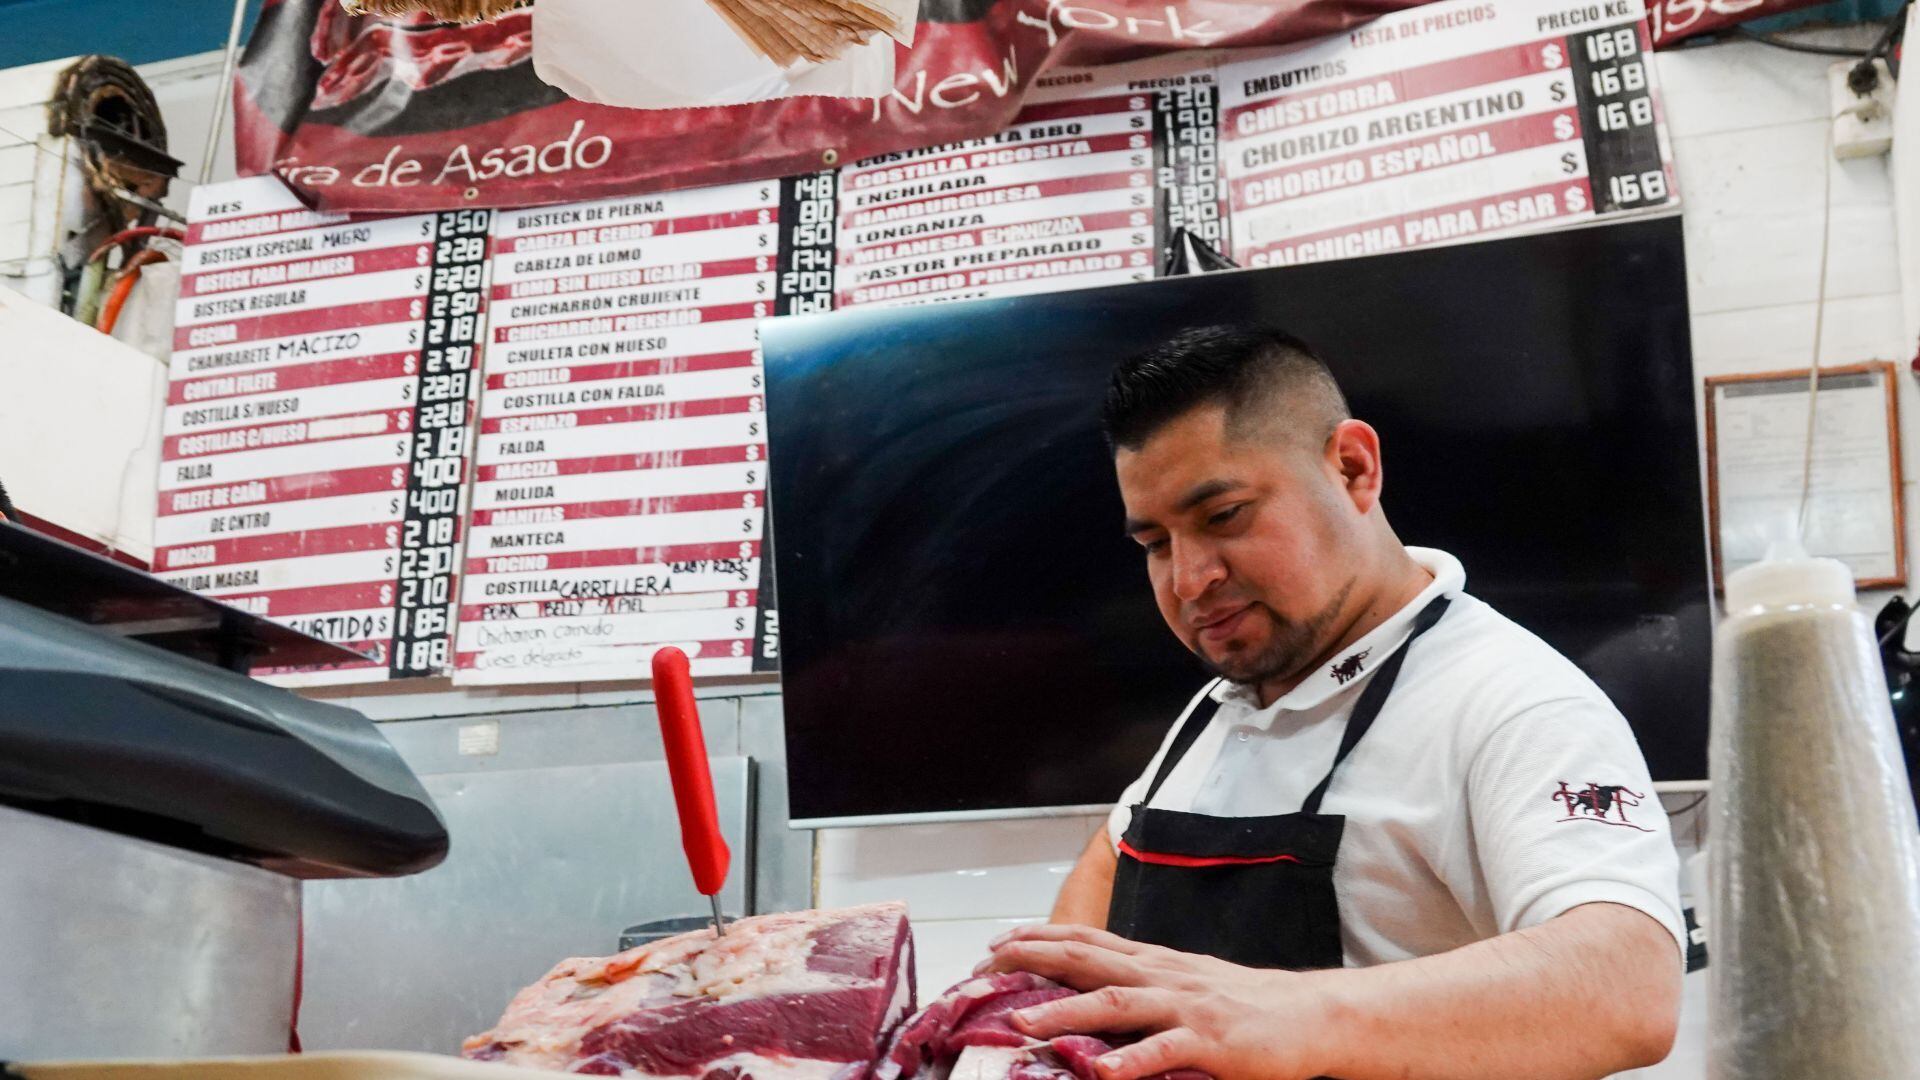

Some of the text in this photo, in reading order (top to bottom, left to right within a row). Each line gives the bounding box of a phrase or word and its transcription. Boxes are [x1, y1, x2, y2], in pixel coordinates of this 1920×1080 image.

[1351, 3, 1496, 49] LISTA DE PRECIOS
[1537, 5, 1600, 31] PRECIO
[872, 0, 1225, 122] New York
[1128, 76, 1185, 90] PRECIO
[1236, 80, 1397, 135] CHISTORRA
[1586, 28, 1637, 62] 168
[1243, 59, 1347, 97] EMBUTIDOS
[1242, 125, 1359, 169] CHORIZO
[1368, 89, 1524, 141] ARGENTINO
[1591, 62, 1645, 97] 168
[993, 130, 1022, 143] LA
[1029, 123, 1083, 139] BBQ
[352, 145, 422, 187] de
[432, 119, 613, 185] Asado
[854, 156, 968, 187] COSTILLA
[970, 140, 1092, 169] PICOSITA
[1244, 159, 1365, 205] CHORIZO
[1370, 131, 1496, 180] ESPAÑOL
[1597, 96, 1654, 132] 168
[517, 175, 834, 229] BISTECK DE PIERNA 148
[853, 185, 1041, 229] HAMBURGUESA
[856, 175, 987, 206] ENCHILADA
[208, 201, 242, 215] RES
[1251, 225, 1401, 268] SALCHICHA
[1403, 209, 1478, 245] PARA
[1481, 193, 1557, 229] ASAR
[1610, 170, 1667, 204] 168
[201, 249, 252, 265] BISTECK
[256, 239, 313, 258] ESPECIAL
[322, 228, 371, 249] MAGRO
[439, 210, 488, 237] 250
[514, 198, 834, 253] CABEZA DE CERDO 80
[856, 214, 986, 244] LONGANIZA
[436, 237, 484, 264] 228
[514, 221, 833, 274] CABEZA DE LOMO 150
[853, 233, 976, 264] MILANESA
[856, 238, 1102, 282] PASTOR PREPARADO
[194, 300, 245, 318] BISTECK
[249, 290, 307, 310] REGULAR
[433, 264, 482, 292] 228
[511, 279, 557, 298] LOMO
[557, 275, 586, 293] SIN
[511, 270, 832, 319] CHICHARRÓN CRUJIENTE 200
[852, 273, 966, 304] SUADERO
[969, 254, 1123, 286] PREPARADO
[432, 292, 479, 317] 250
[615, 308, 702, 332] PRENSADO
[188, 315, 475, 371] CHAMBARETE MACIZO 218
[508, 337, 667, 364] CHULETA CON HUESO
[503, 367, 571, 388] CODILLO
[183, 372, 467, 426] COSTILLA S/HUESO 228
[503, 383, 665, 409] COSTILLA CON FALDA
[178, 429, 246, 456] COSTILLAS
[420, 400, 465, 429] 228
[500, 413, 578, 434] ESPINAZO
[177, 426, 464, 482] FALDA 218
[499, 440, 546, 455] FALDA
[212, 487, 229, 506] DE
[413, 457, 461, 488] 400
[496, 460, 559, 480] MACIZA
[495, 485, 554, 502] MOLIDA
[211, 488, 457, 533] DE CNTRO 400
[491, 506, 565, 526] MANITAS
[403, 517, 454, 548] 218
[490, 531, 565, 548] MANTECA
[215, 569, 260, 588] MAGRA
[400, 545, 453, 579] 230
[486, 555, 549, 573] TOCINO
[401, 576, 449, 608] 210
[485, 576, 672, 598] COSTILLA CARRILLERA
[399, 608, 446, 638] 185
[396, 638, 449, 671] 188
